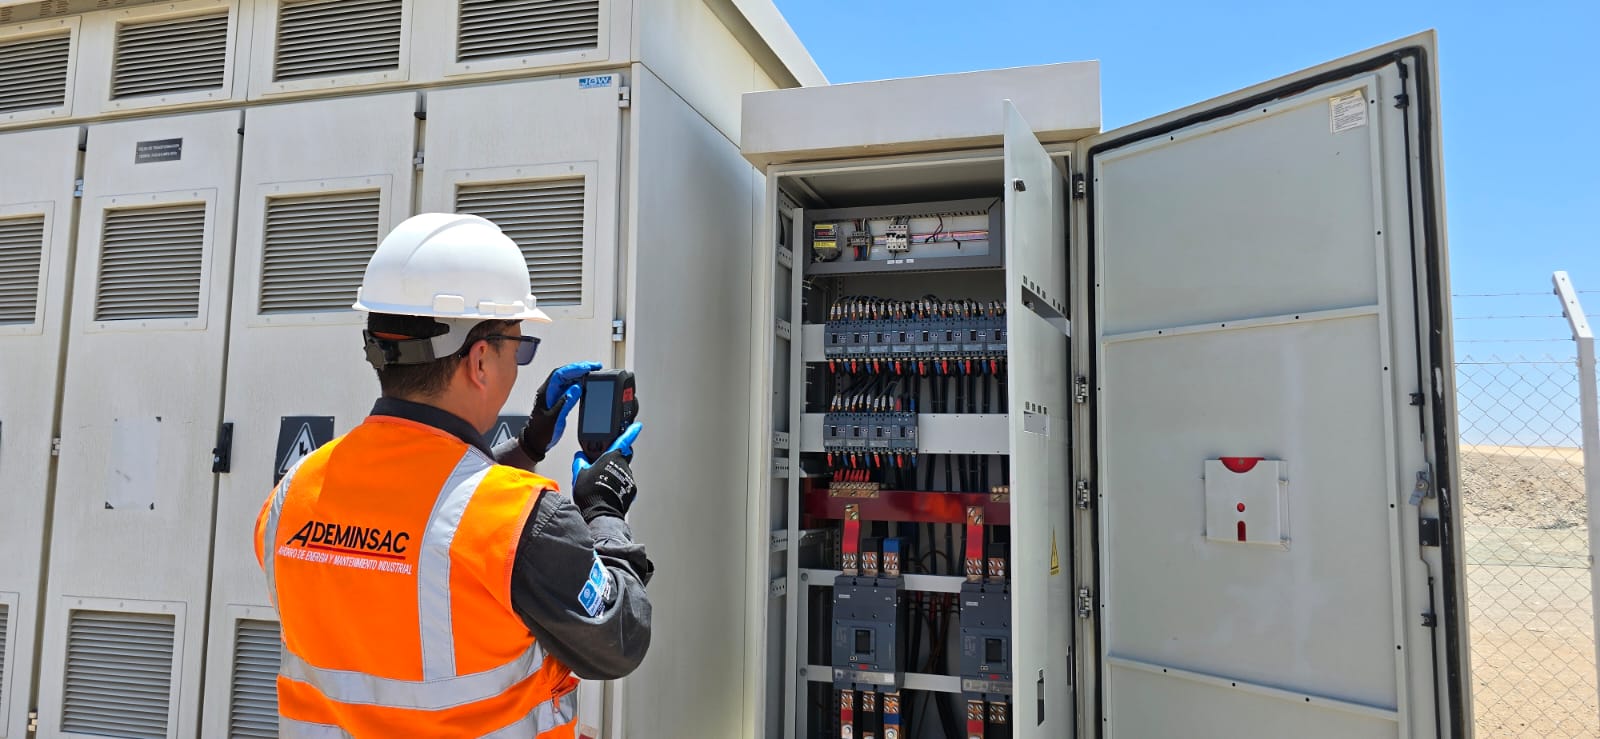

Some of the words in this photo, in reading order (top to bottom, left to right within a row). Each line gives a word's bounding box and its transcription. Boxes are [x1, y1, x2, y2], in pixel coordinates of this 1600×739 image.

[286, 520, 410, 553] ADEMINSAC
[278, 545, 298, 559] AHORRO
[297, 549, 307, 560] DE
[327, 553, 334, 564] Y
[378, 560, 412, 575] INDUSTRIAL
